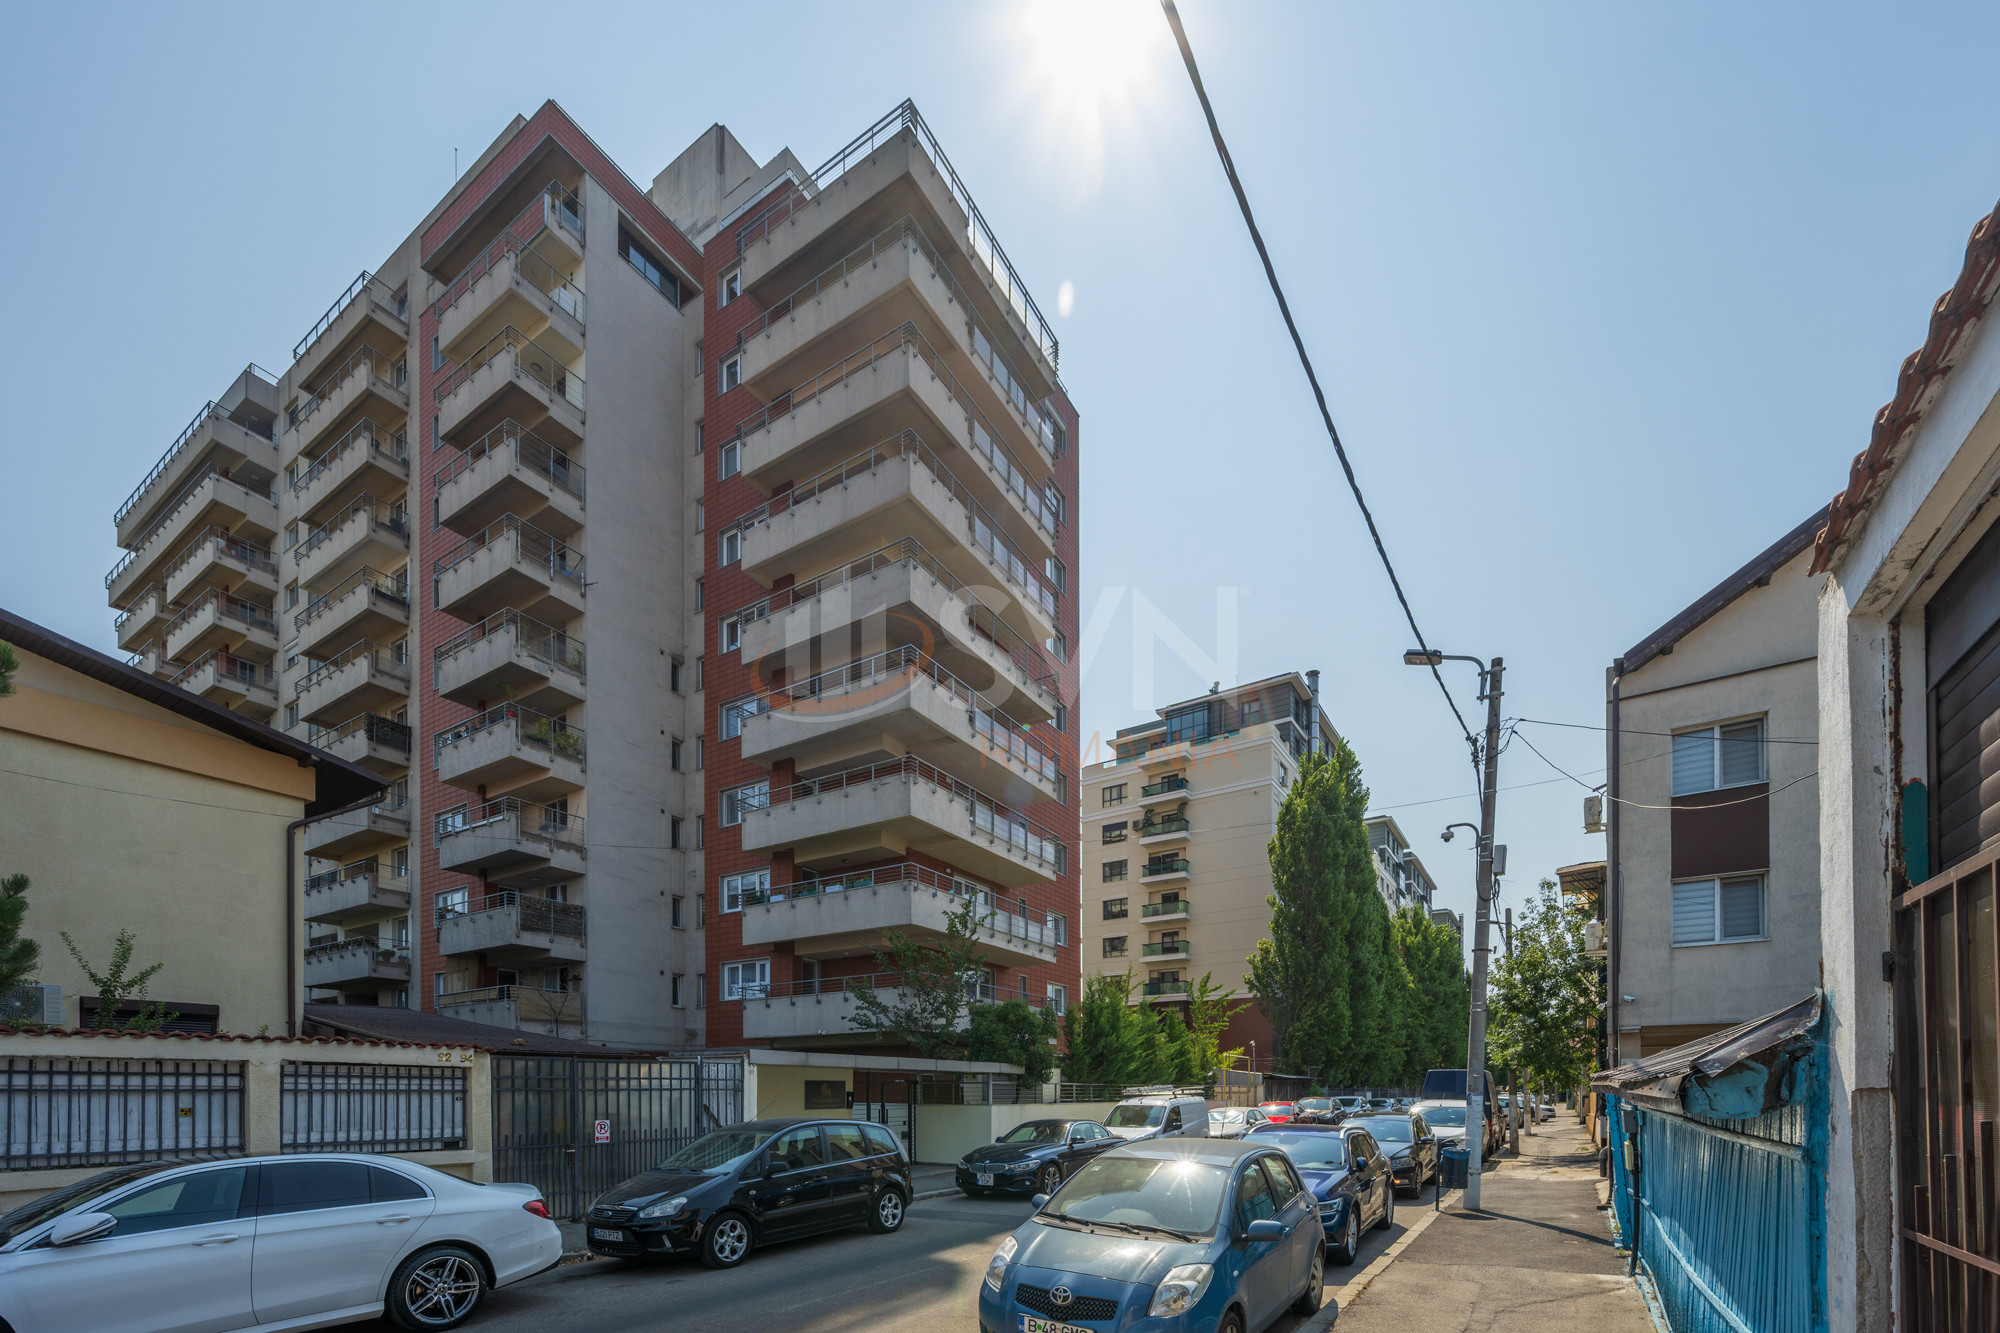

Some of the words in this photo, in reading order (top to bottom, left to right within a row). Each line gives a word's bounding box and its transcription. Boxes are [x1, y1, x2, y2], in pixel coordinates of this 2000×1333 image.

[438, 1052, 451, 1062] 92
[460, 1054, 473, 1063] 94
[1028, 1319, 1038, 1332] B
[1042, 1322, 1057, 1333] 48
